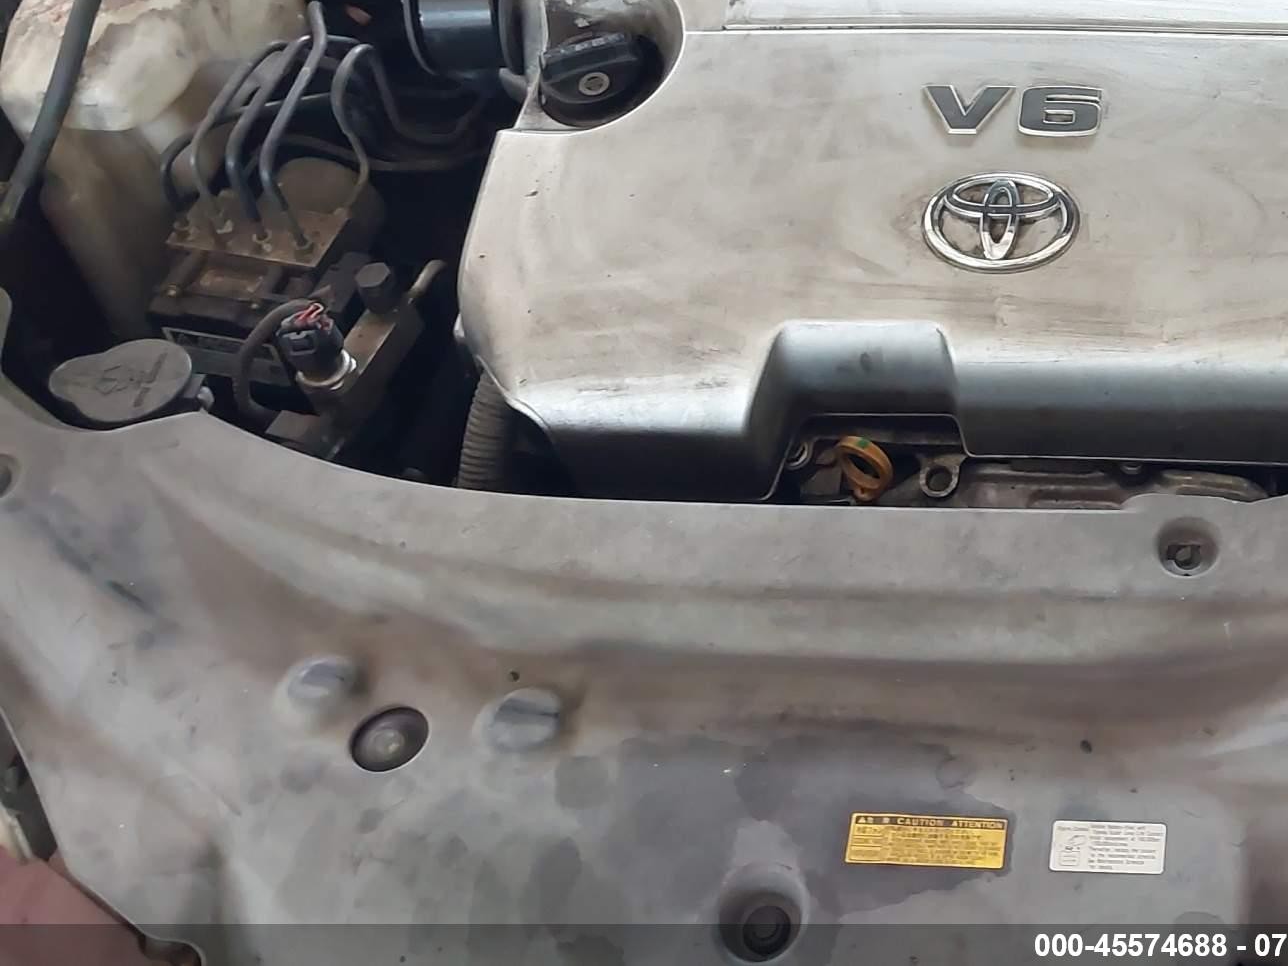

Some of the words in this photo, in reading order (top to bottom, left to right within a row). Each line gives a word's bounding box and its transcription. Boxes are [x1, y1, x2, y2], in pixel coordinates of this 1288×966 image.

[922, 85, 1102, 136] V6
[897, 817, 944, 827] CAUTION
[951, 820, 1003, 829] ATTENTION
